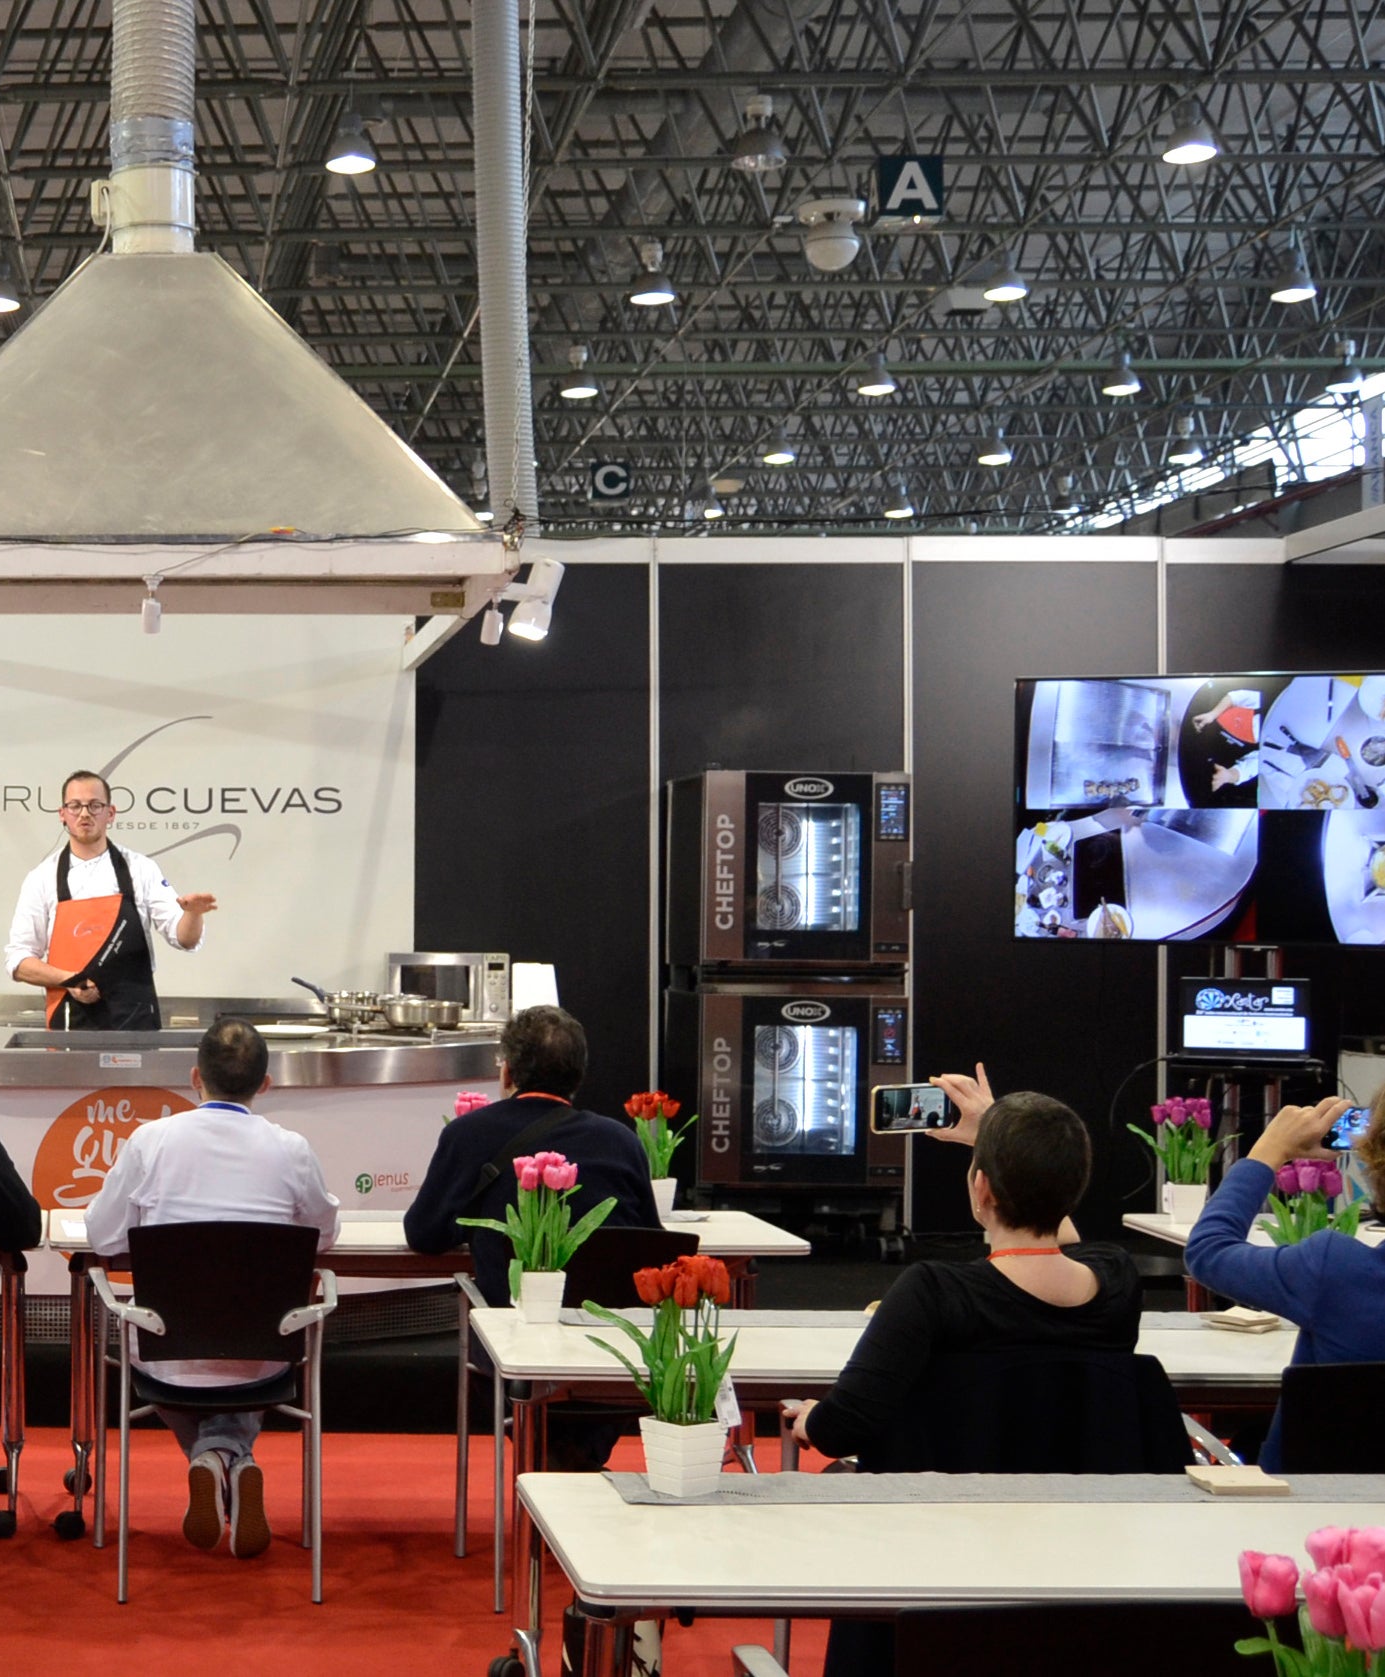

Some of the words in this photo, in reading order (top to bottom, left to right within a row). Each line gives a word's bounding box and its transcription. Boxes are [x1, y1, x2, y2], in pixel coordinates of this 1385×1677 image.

[886, 160, 938, 209] A
[595, 464, 627, 495] C
[146, 786, 343, 815] CUEVAS
[790, 783, 826, 793] UNOX
[106, 821, 158, 830] DESDE
[165, 821, 200, 830] 1867
[715, 814, 735, 930] CHEFTOP
[711, 1037, 732, 1153] CHEFTOP
[87, 1099, 136, 1124] me
